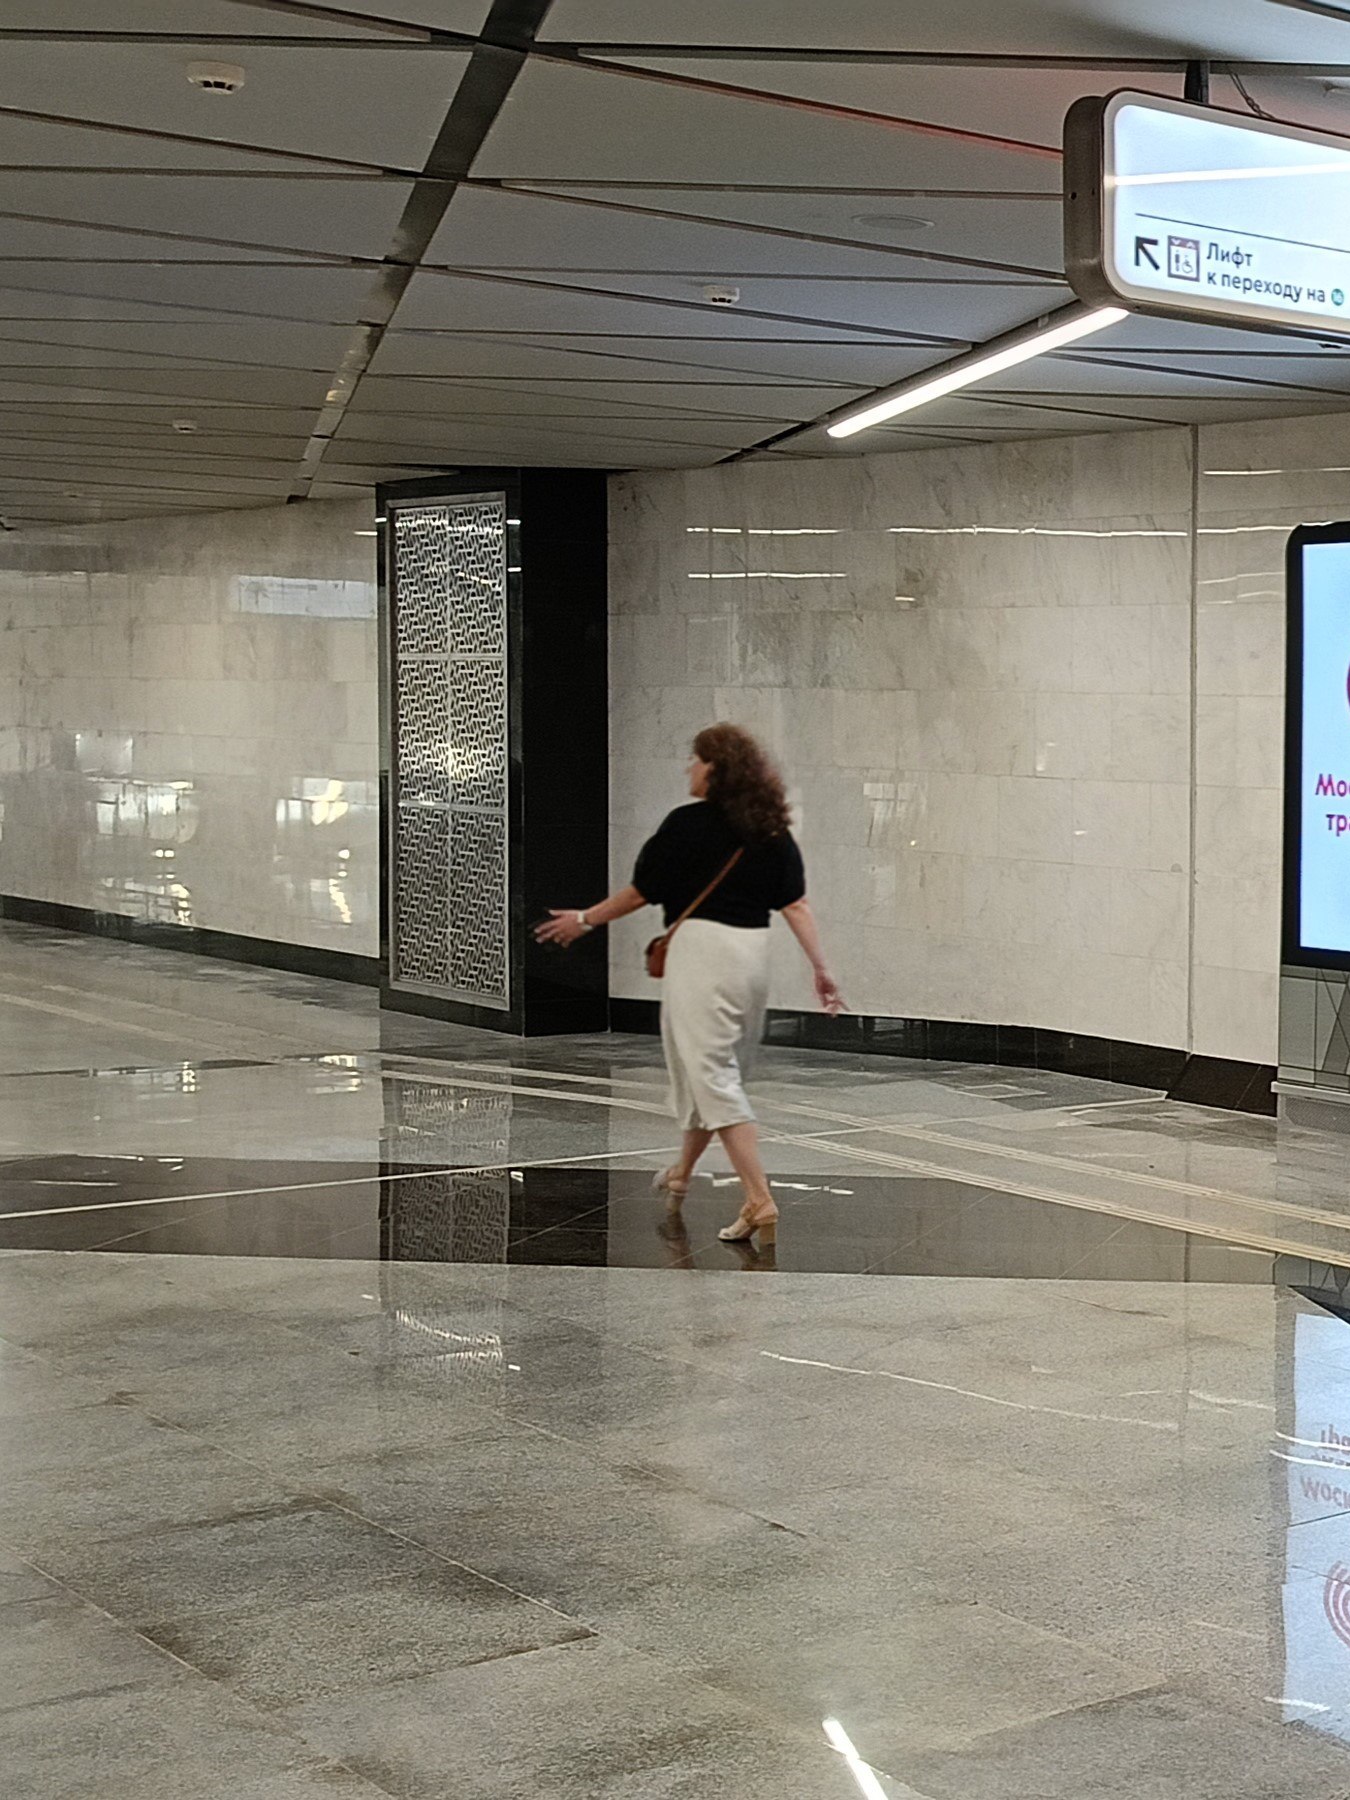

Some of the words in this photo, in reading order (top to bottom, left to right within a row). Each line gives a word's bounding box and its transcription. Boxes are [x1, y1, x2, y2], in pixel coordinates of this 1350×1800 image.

[1206, 242, 1253, 269] Лифт
[1207, 272, 1217, 286] к
[1221, 273, 1303, 303] переходу
[1307, 288, 1326, 303] на
